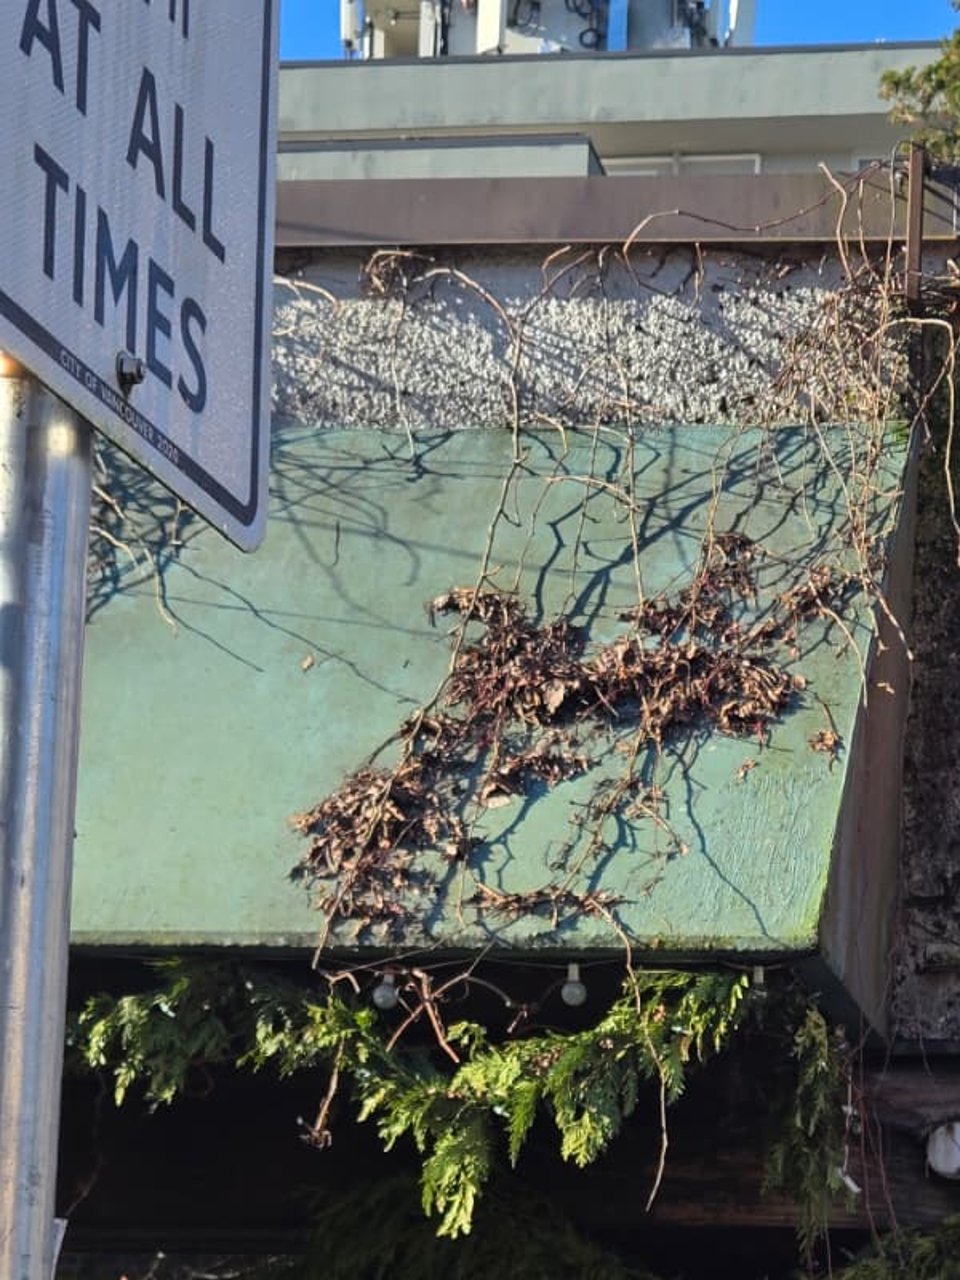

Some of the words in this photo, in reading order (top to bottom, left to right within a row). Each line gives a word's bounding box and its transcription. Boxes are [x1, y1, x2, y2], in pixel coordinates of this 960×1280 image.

[19, 0, 101, 117] AT
[126, 67, 225, 263] ALL
[34, 143, 207, 414] TIMES
[60, 350, 80, 379] CITY
[84, 372, 97, 394] OF
